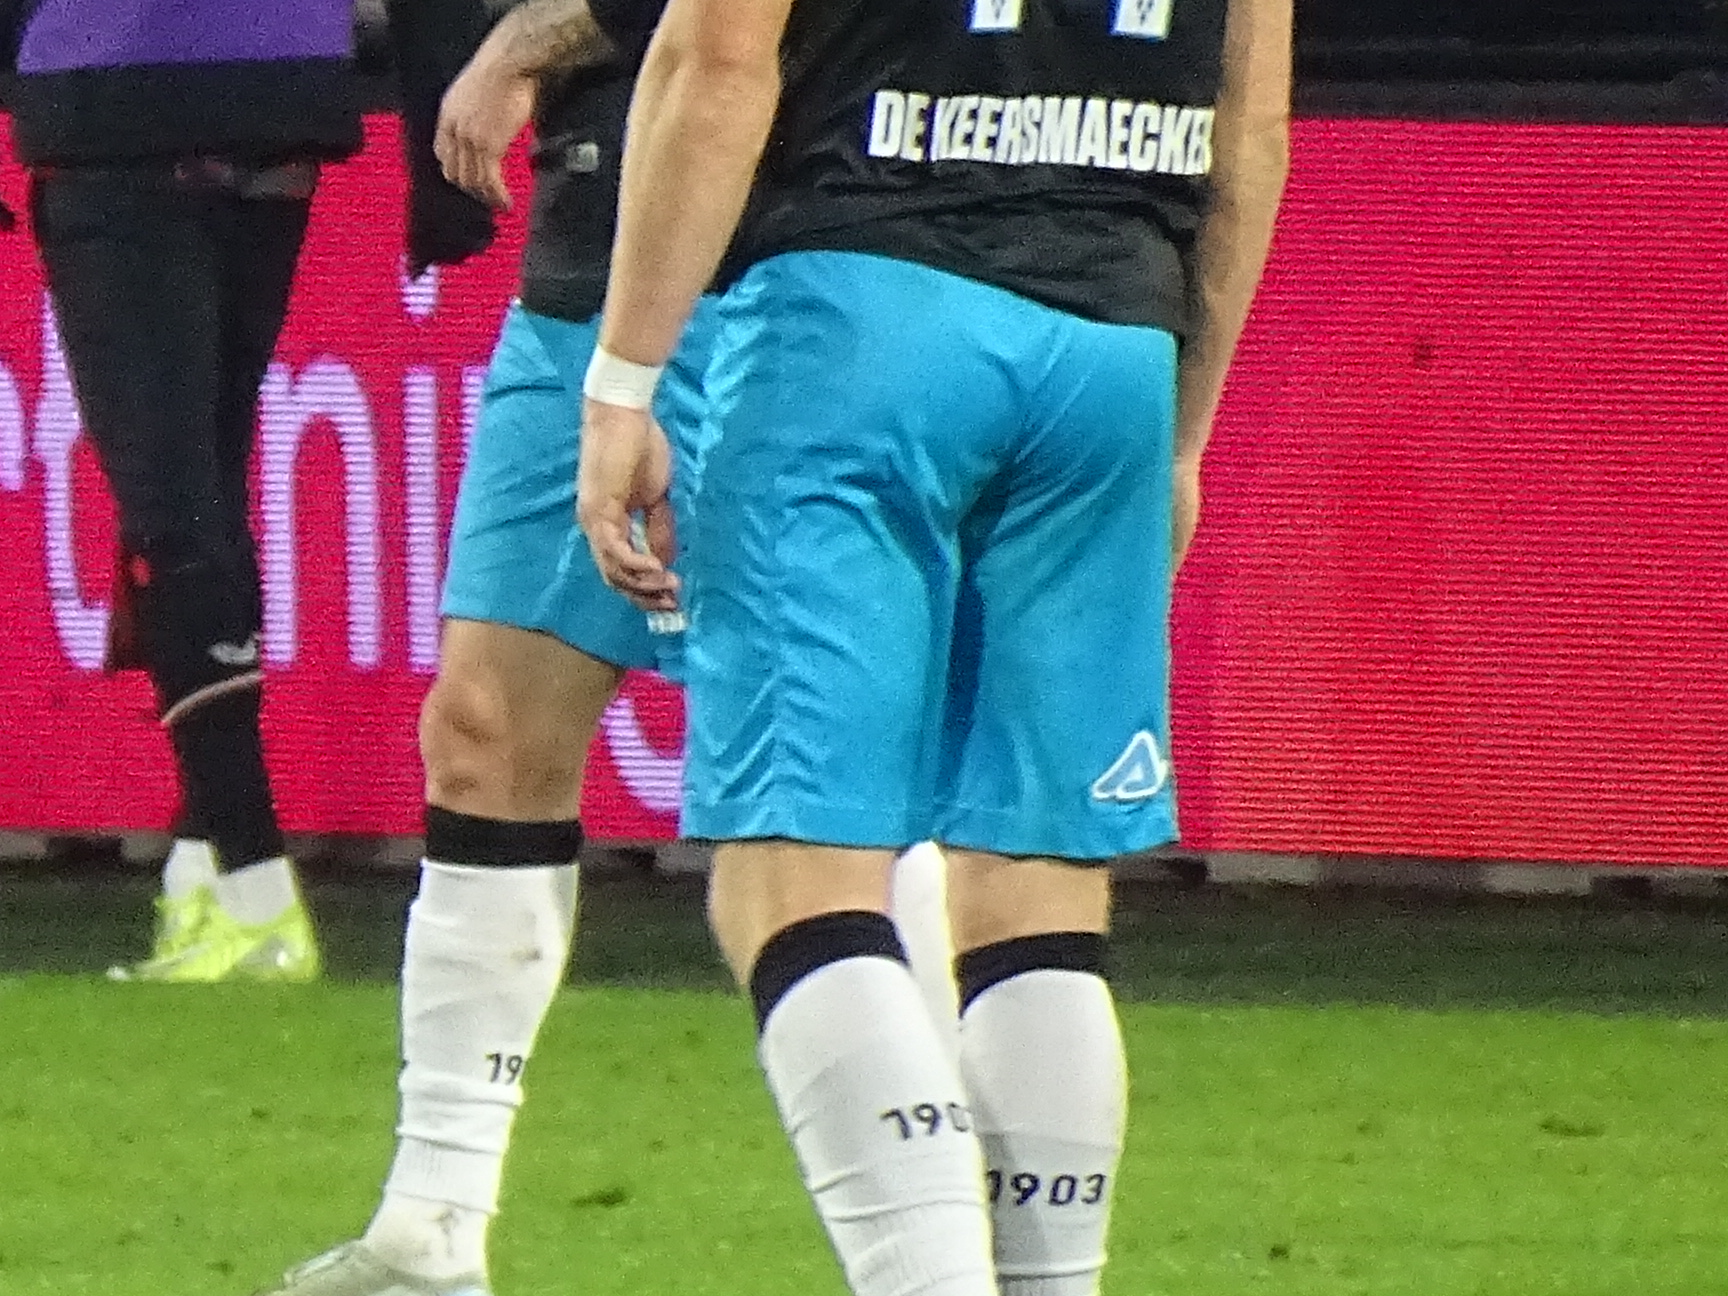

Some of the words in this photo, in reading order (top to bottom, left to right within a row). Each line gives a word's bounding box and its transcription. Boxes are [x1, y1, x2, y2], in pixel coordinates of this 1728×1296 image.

[867, 89, 931, 162] DE
[485, 1053, 523, 1085] 19
[986, 1169, 1105, 1206] 1903
